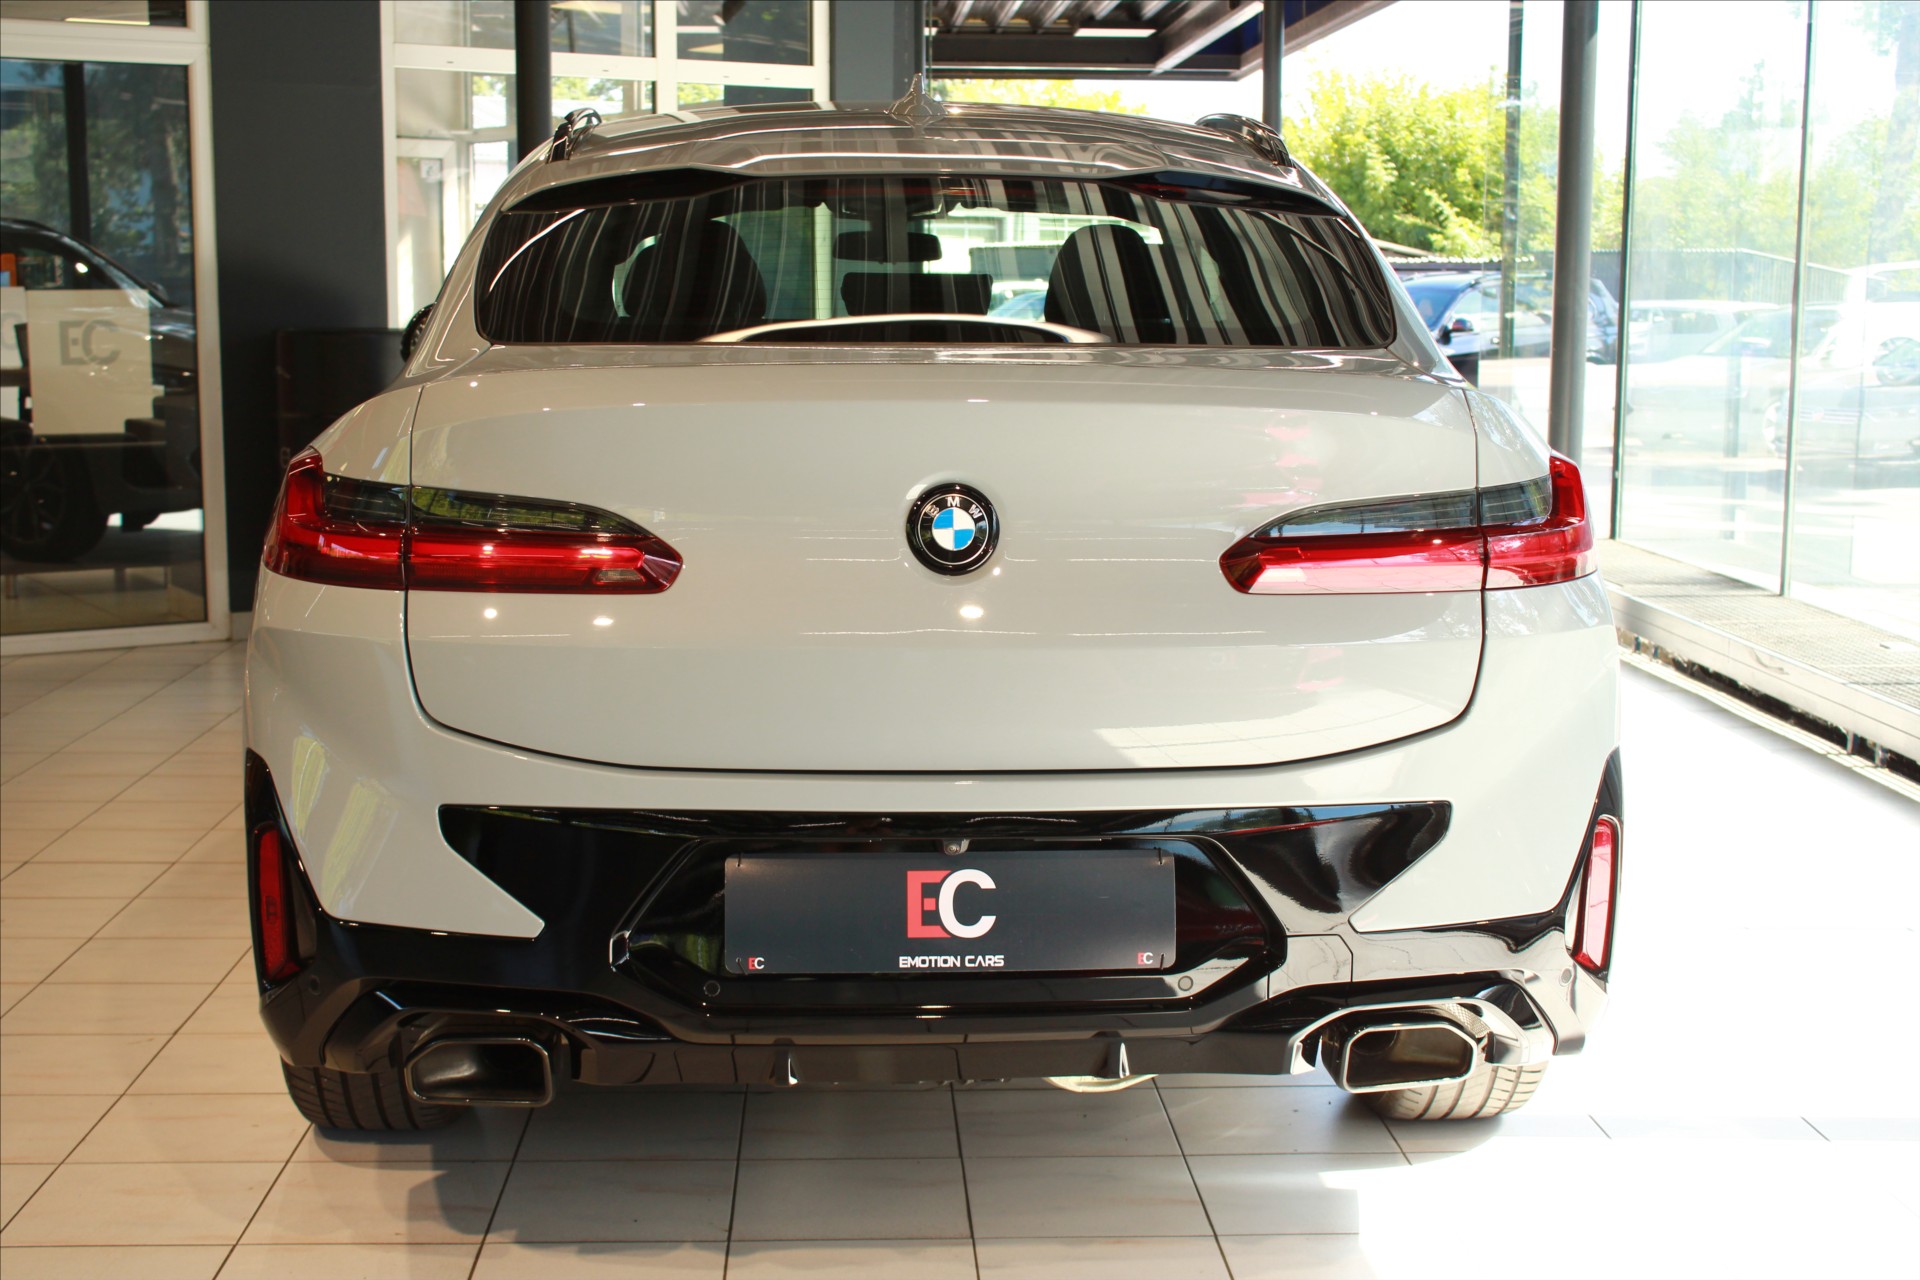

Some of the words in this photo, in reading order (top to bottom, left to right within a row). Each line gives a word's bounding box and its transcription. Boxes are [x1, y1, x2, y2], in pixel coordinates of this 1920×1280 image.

[59, 319, 121, 366] EC
[925, 496, 983, 519] BMW
[906, 868, 997, 939] EC
[748, 957, 765, 970] EC
[899, 955, 961, 968] EMOTION
[964, 955, 1005, 967] CARS
[1137, 952, 1154, 965] EC
